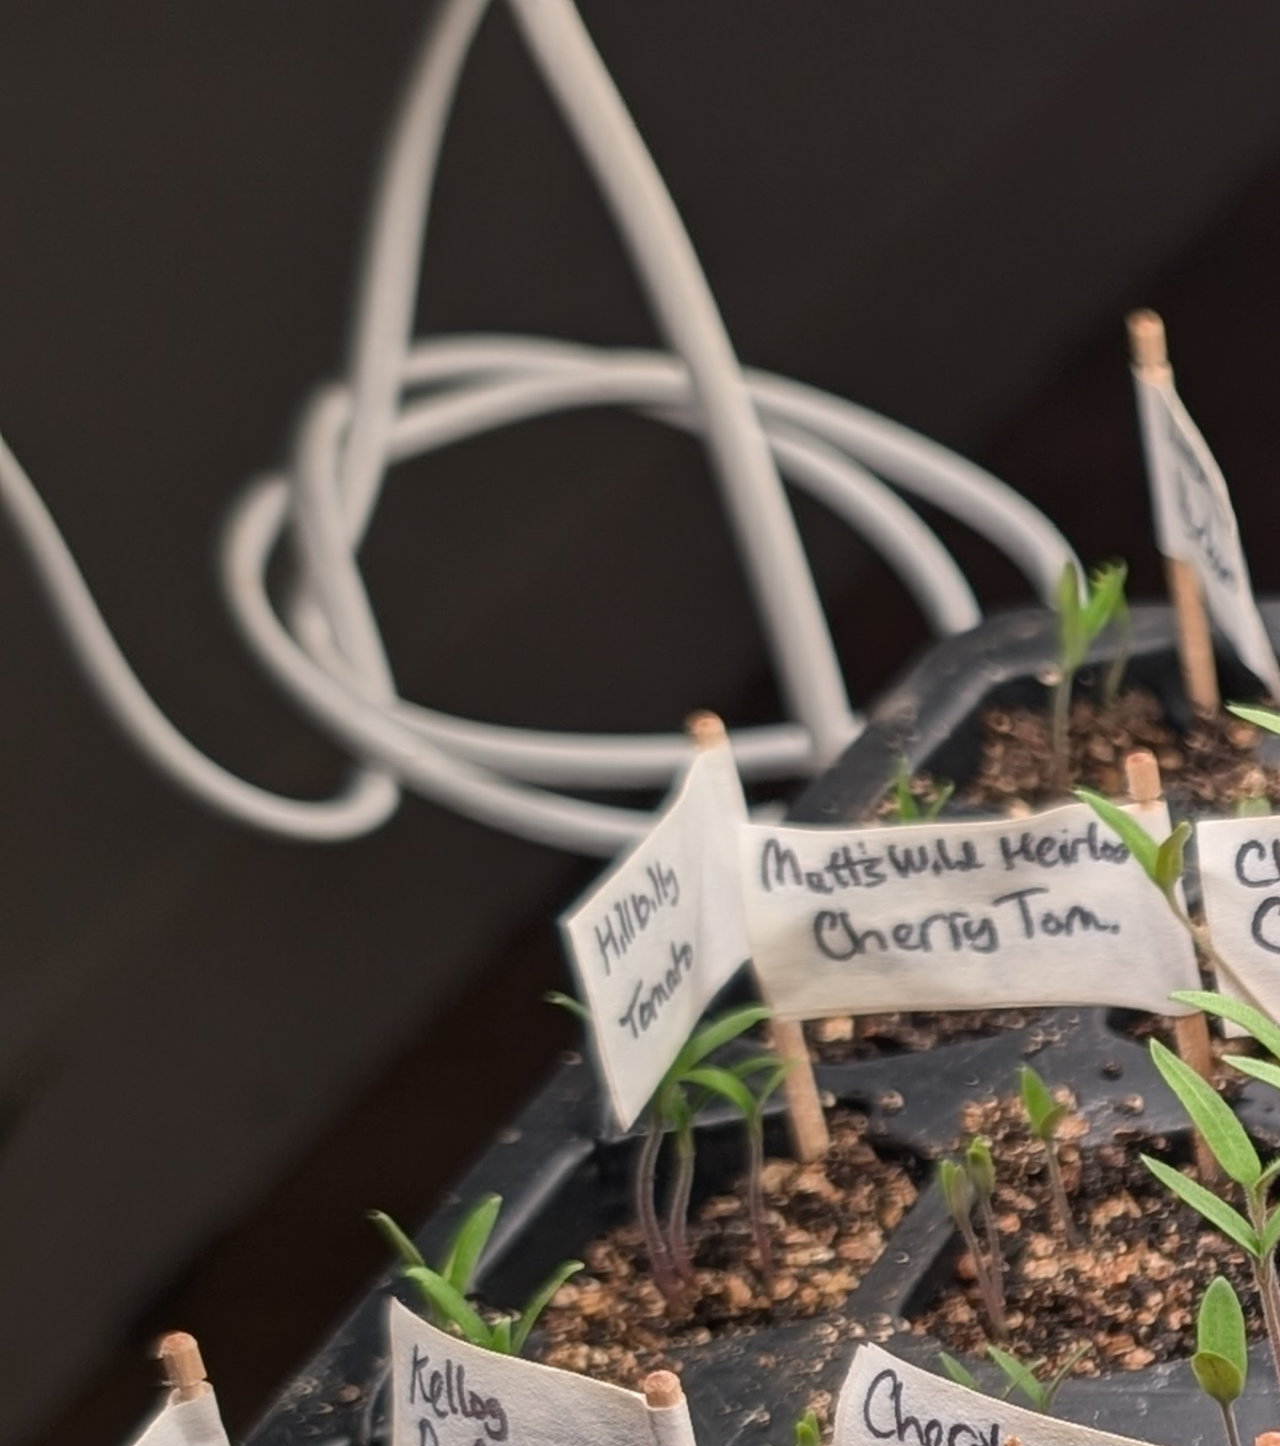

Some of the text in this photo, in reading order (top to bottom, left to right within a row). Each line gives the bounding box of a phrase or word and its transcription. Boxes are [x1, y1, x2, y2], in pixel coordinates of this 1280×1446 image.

[594, 861, 681, 976] Hillbilly
[812, 887, 1121, 963] Cherry Tom.
[620, 940, 694, 1039] Tomato
